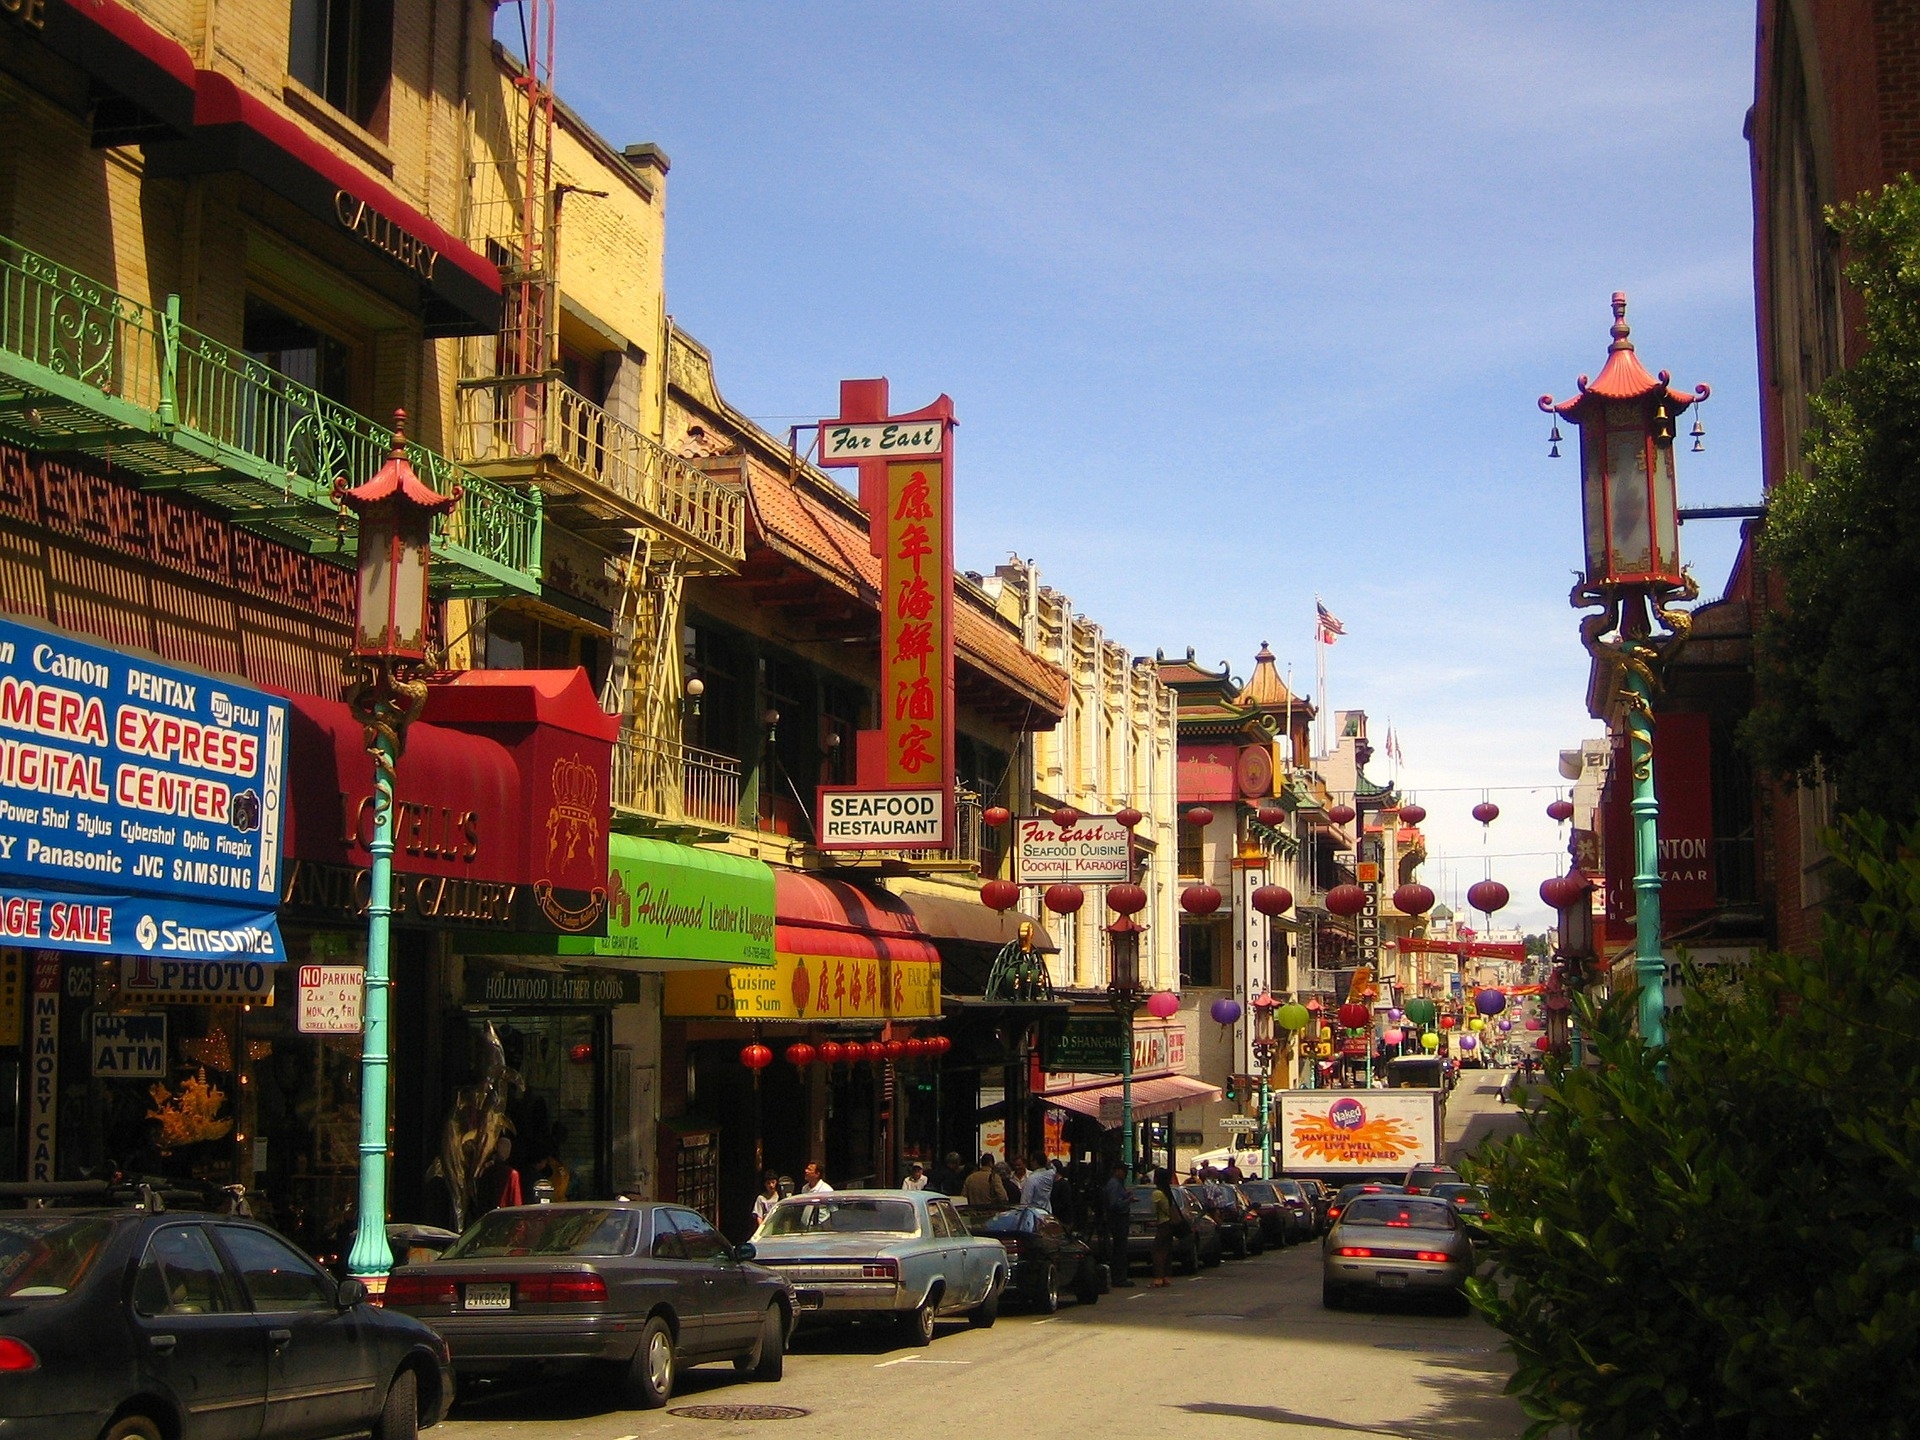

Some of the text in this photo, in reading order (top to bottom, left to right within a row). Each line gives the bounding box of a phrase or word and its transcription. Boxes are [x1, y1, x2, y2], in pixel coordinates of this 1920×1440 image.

[335, 189, 438, 280] GALLERY
[831, 425, 934, 453] Far East
[893, 469, 936, 775] 康年海鮮酒家
[33, 643, 109, 689] Canon
[127, 668, 196, 712] PENTAX
[234, 705, 259, 728] FUJI
[115, 704, 259, 778] EXPRESS
[0, 738, 231, 825] IGITAL CENTER
[261, 714, 281, 887] MINOLTA
[830, 796, 935, 818] SEAFOOD
[0, 799, 252, 860] Power Shot Stylus Cybershot Optio Finepix
[828, 819, 938, 836] RESTAURANT
[1021, 821, 1056, 844] Far
[1059, 824, 1104, 843] East
[1023, 842, 1126, 857] SEAFOOD CUISINE
[27, 838, 122, 874] Panasonic
[133, 853, 163, 880] JVC
[173, 858, 252, 890] SAMSUNG
[1021, 858, 1127, 872] COCKTAIL KARAOKE
[283, 859, 407, 917] ANTIQE
[416, 876, 518, 922] GALLERY
[1250, 875, 1258, 927] Bk
[636, 882, 706, 938] Hollywood
[709, 902, 738, 933] Leather
[746, 906, 773, 942] Luggage
[1363, 882, 1375, 929] FOUR
[49, 901, 112, 944] SALE
[162, 920, 274, 954] Samsonite
[36, 964, 58, 976] LINE
[68, 967, 91, 998] 625
[161, 962, 263, 990] PHOTO
[303, 968, 362, 986] NO PARKING
[726, 973, 776, 991] Cuisine
[486, 978, 624, 1000] HOLLYWOOD LEATHER GOODS
[716, 994, 781, 1012] Dim Sum
[1071, 1035, 1121, 1048] SHANGHAI
[35, 998, 56, 1114] MEMORY
[97, 1046, 161, 1071] ATM
[1332, 1105, 1361, 1123] Naked
[1302, 1133, 1350, 1142] HAVE FUN
[1324, 1141, 1372, 1150] LIVE WELL
[1343, 1150, 1396, 1159] GET NAKED
